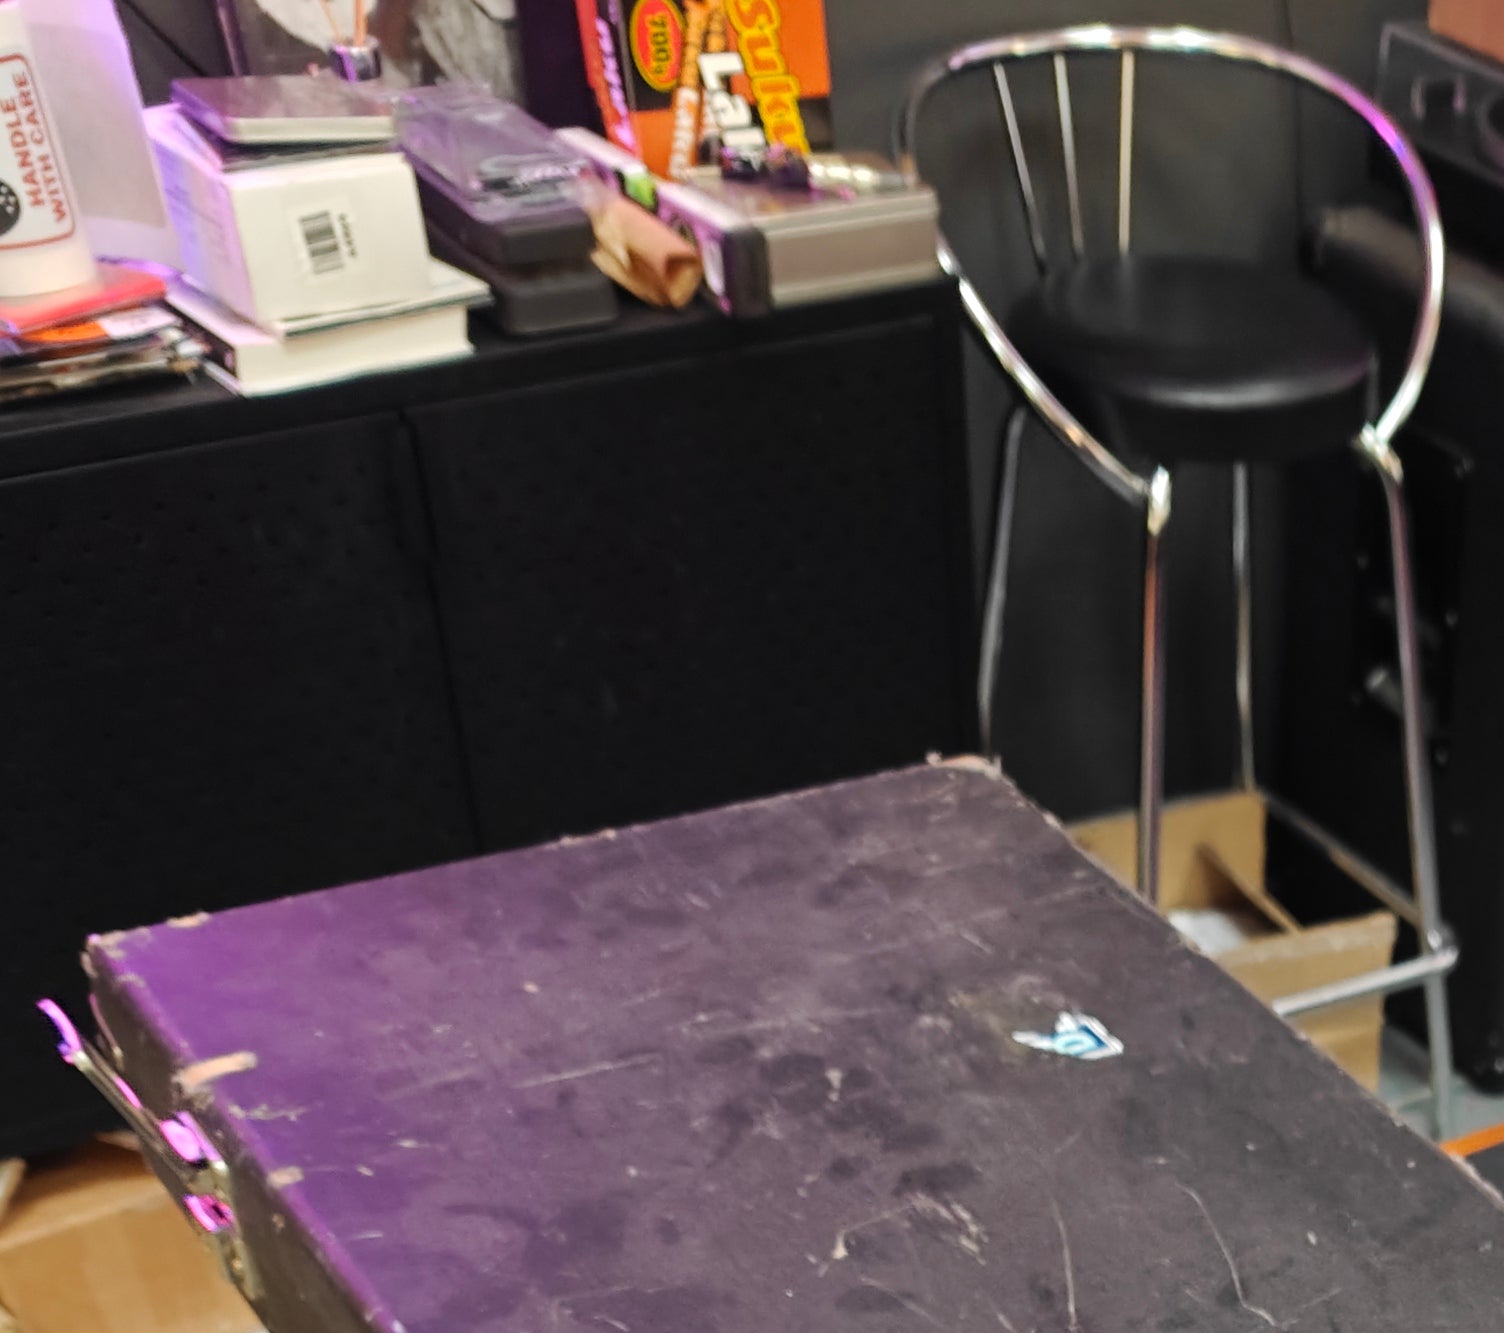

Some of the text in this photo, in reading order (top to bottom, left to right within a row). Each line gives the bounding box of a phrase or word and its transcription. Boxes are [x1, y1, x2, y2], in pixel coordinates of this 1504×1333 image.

[1, 97, 45, 206] HANDLE
[12, 73, 67, 222] WITH CARE
